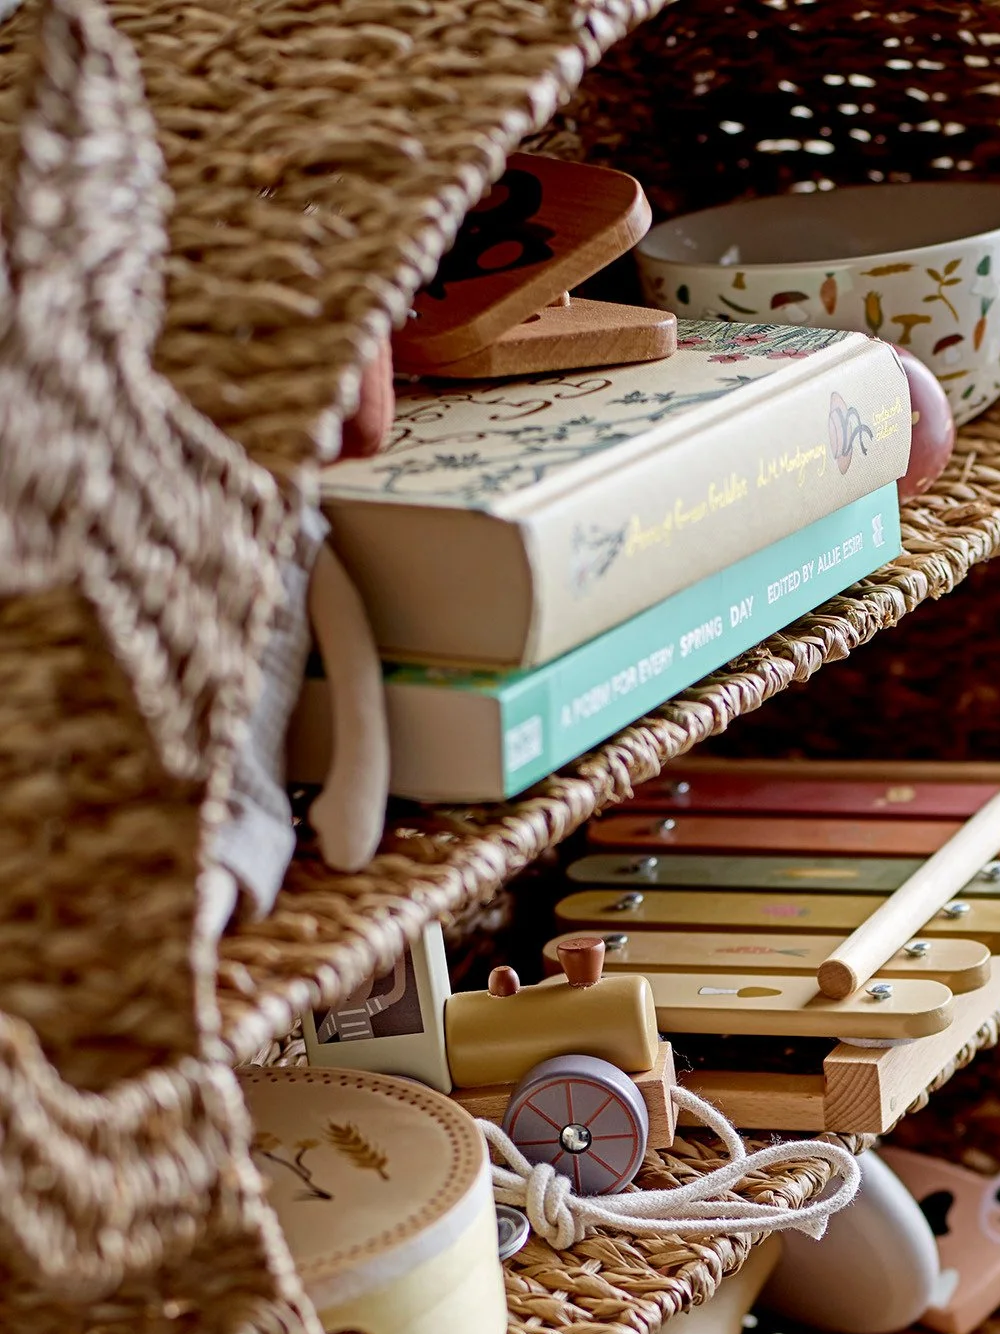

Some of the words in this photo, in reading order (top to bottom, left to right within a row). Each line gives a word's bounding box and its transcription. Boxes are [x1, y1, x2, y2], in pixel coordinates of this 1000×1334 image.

[767, 570, 800, 604] EDITED
[802, 560, 815, 583] BY
[817, 545, 841, 575] ALLIE
[843, 532, 864, 560] ESIRI
[561, 704, 572, 730] A
[572, 680, 611, 723] POEM
[612, 665, 638, 699] FOR
[638, 643, 675, 684] EVERY
[679, 615, 723, 658] SPRING
[730, 595, 754, 628] DAY
